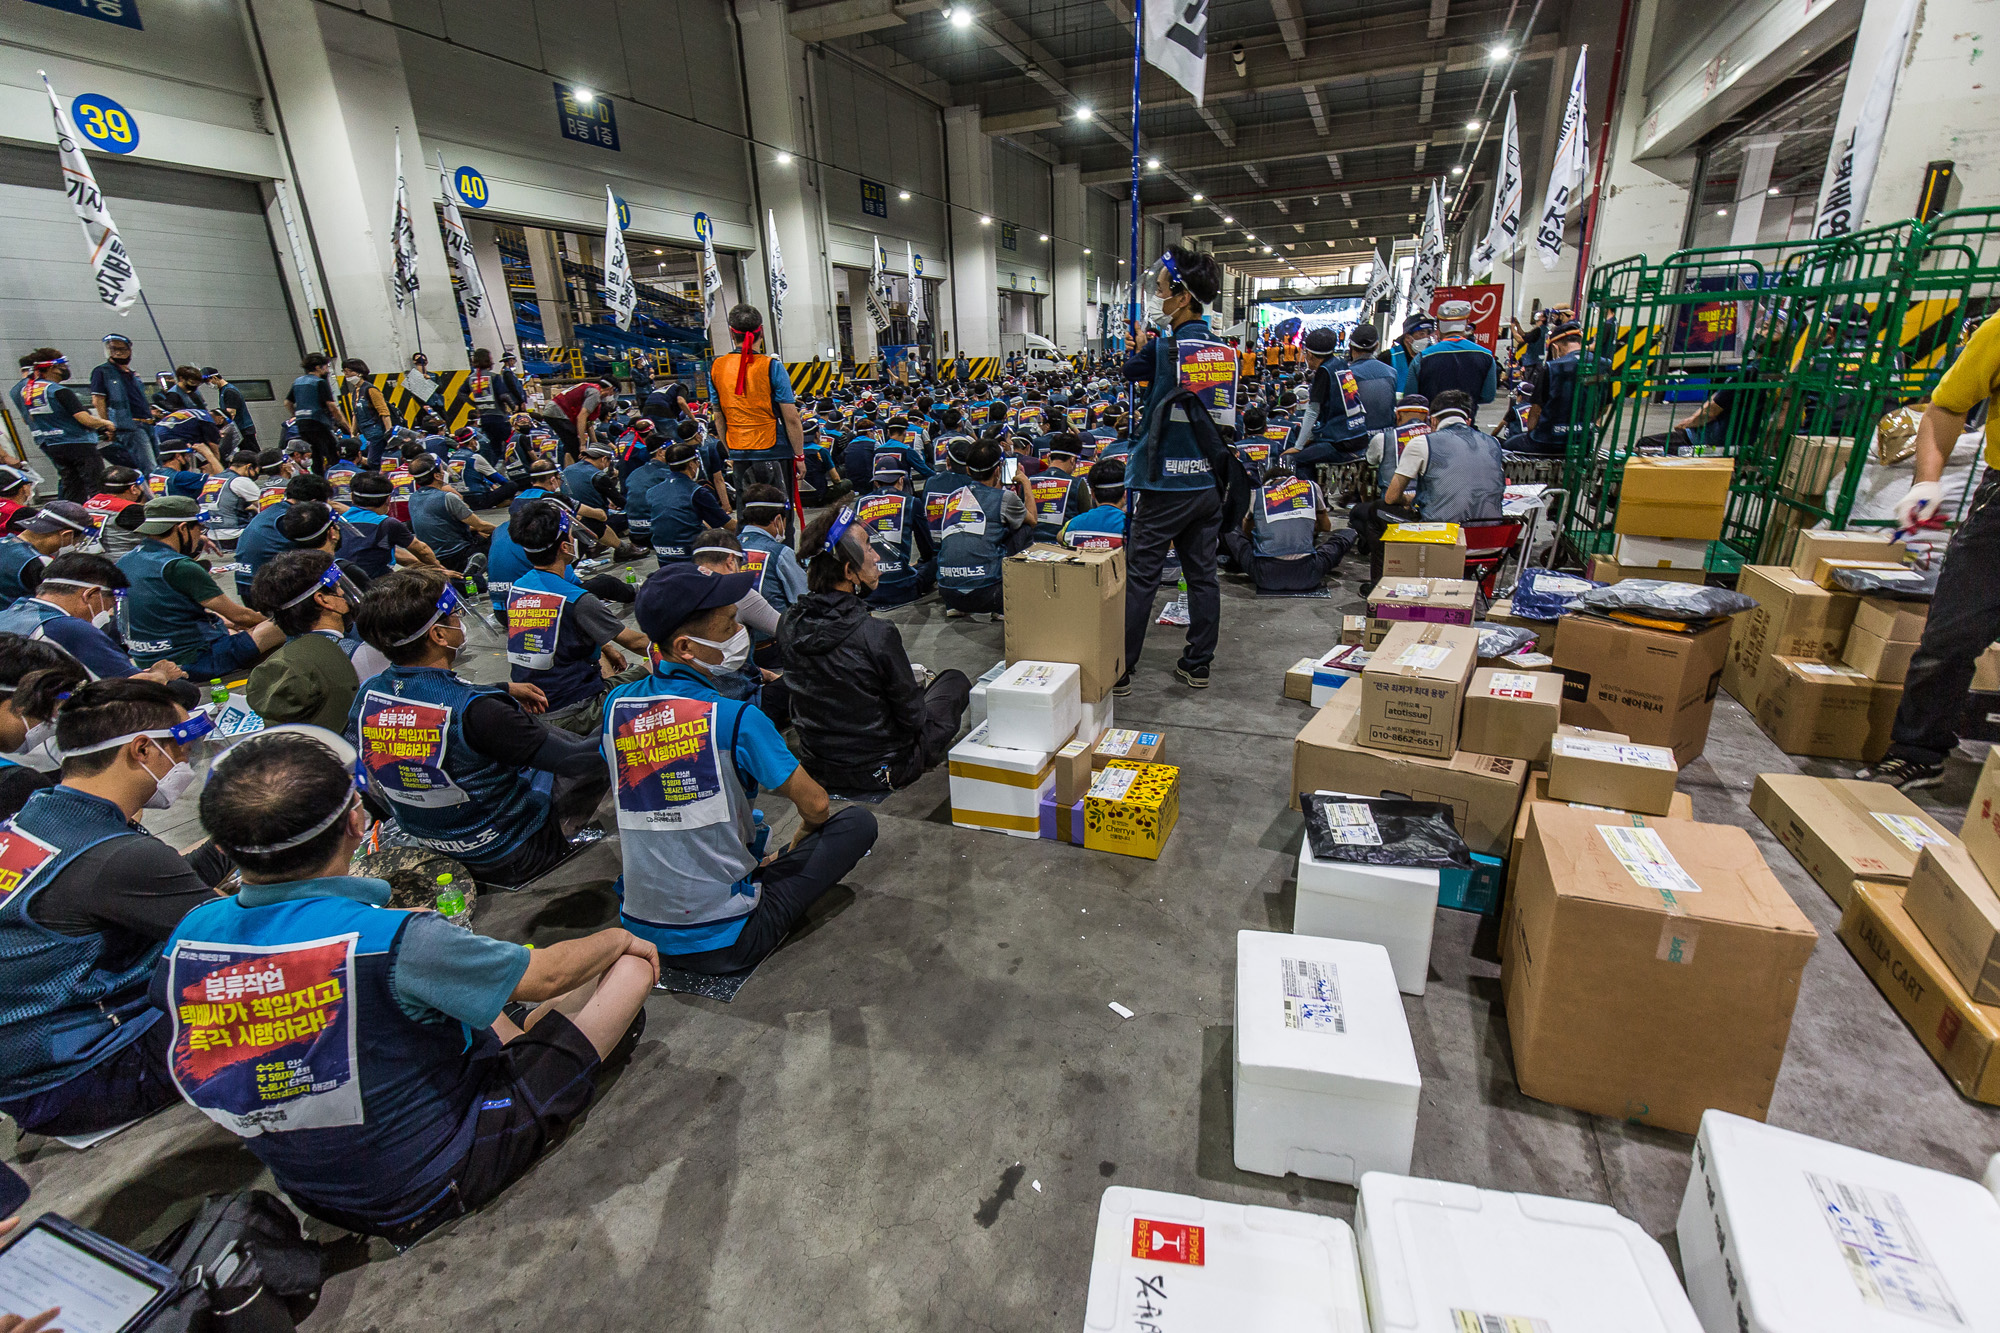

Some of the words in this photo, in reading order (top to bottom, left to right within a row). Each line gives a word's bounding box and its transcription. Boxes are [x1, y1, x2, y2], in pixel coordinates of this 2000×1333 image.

[79, 103, 132, 144] 39
[567, 117, 590, 140] B동
[593, 125, 613, 146] 1층
[461, 174, 485, 201] 40
[615, 203, 628, 224] 1
[1391, 683, 1413, 695] 최저가
[1414, 686, 1430, 697] 최대
[1387, 707, 1429, 720] atotissue
[1598, 691, 1618, 704] 벤타
[1621, 696, 1664, 714] 에어워셔
[378, 712, 417, 727] 분류작업
[633, 707, 676, 733] 분류작업
[397, 728, 441, 742] 책임지고
[615, 732, 656, 752] 택배사가
[656, 717, 710, 744] 책임지고
[1372, 730, 1440, 747] 010-8662-6651
[388, 742, 431, 758] 시행하라!
[625, 751, 648, 767] 즉각
[648, 737, 700, 764] 시행하라!
[1105, 824, 1130, 836] Cherry
[1857, 920, 1892, 970] LALLA
[1890, 961, 1926, 1004] CART
[205, 966, 286, 1001] 분류작업
[179, 1002, 249, 1028] 택배사가
[251, 977, 344, 1020] 책임지고
[188, 1030, 233, 1052] 즉각
[238, 1009, 328, 1047] 시행하라!
[255, 1060, 286, 1073] 수수료
[256, 1073, 267, 1083] 주
[257, 1080, 289, 1094] 노동시
[1137, 1219, 1151, 1259] 파손주의
[1188, 1226, 1200, 1265] FRAGILE
